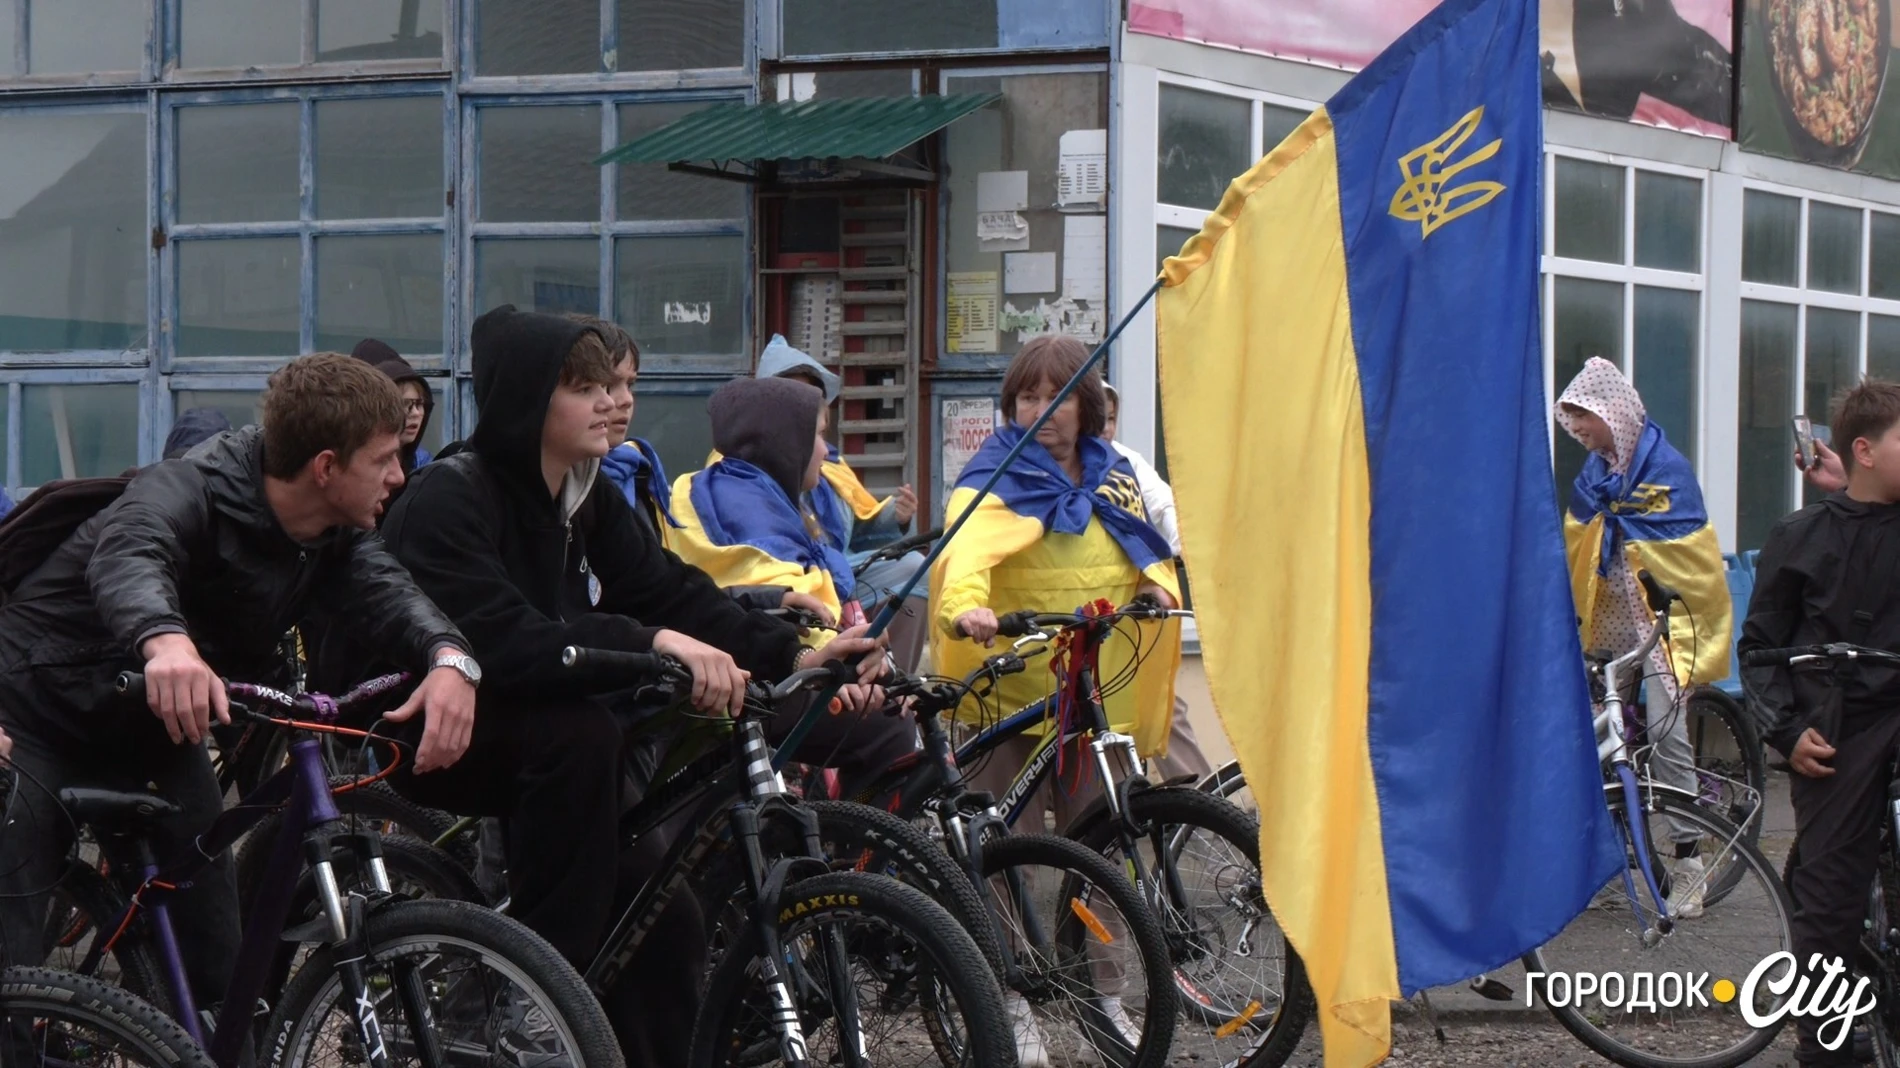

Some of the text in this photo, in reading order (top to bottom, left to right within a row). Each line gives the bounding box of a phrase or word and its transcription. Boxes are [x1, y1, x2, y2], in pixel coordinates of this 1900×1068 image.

[947, 403, 959, 417] 20
[998, 757, 1045, 822] OVERY
[865, 829, 940, 889] KENDA
[779, 894, 859, 924] MAXXIS
[270, 1020, 294, 1068] ENDA
[356, 985, 388, 1060] XCT
